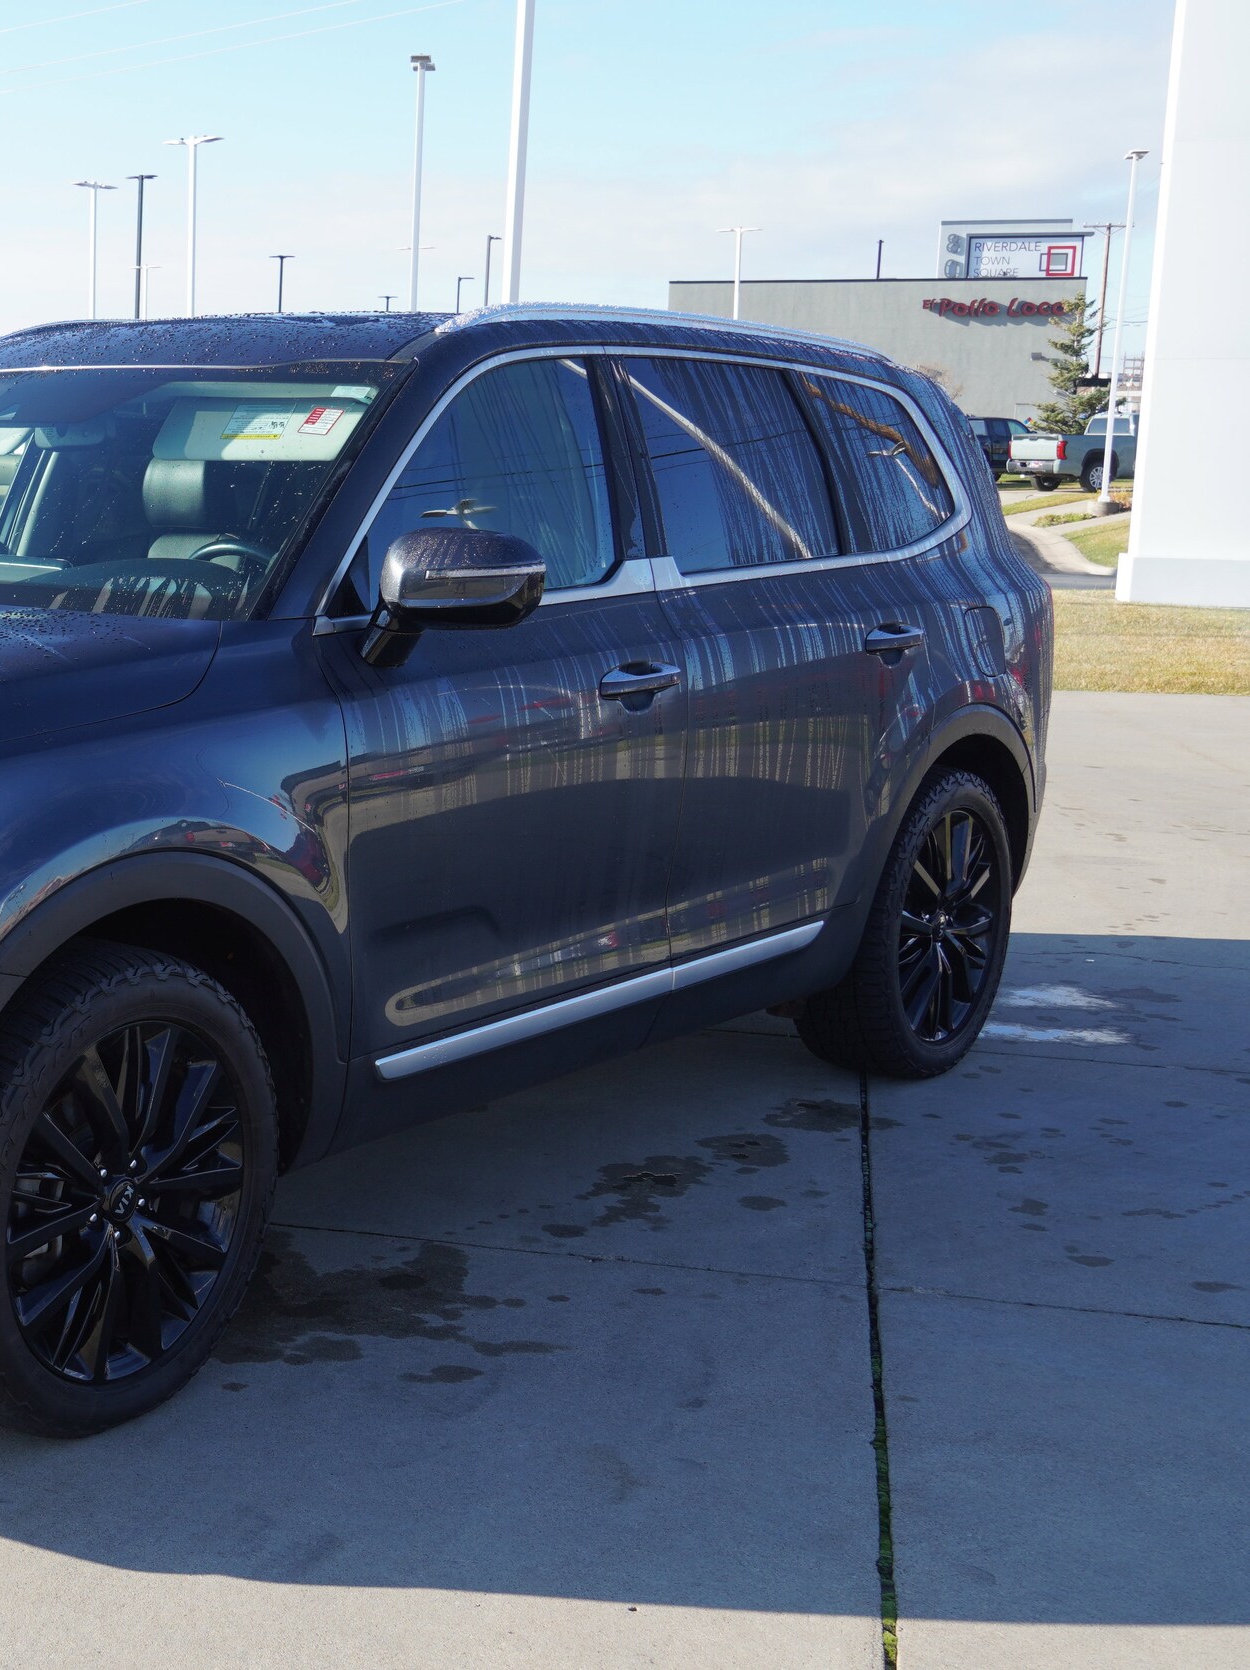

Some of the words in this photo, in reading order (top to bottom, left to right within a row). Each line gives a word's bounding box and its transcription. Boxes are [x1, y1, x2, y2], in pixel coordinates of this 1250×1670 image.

[974, 241, 1042, 252] RIVERDALE
[974, 256, 1010, 265] TOWN
[973, 268, 1019, 278] SQUARE
[939, 297, 1000, 317] Pollo
[1007, 297, 1066, 317] Loco
[114, 1185, 134, 1215] KIA
